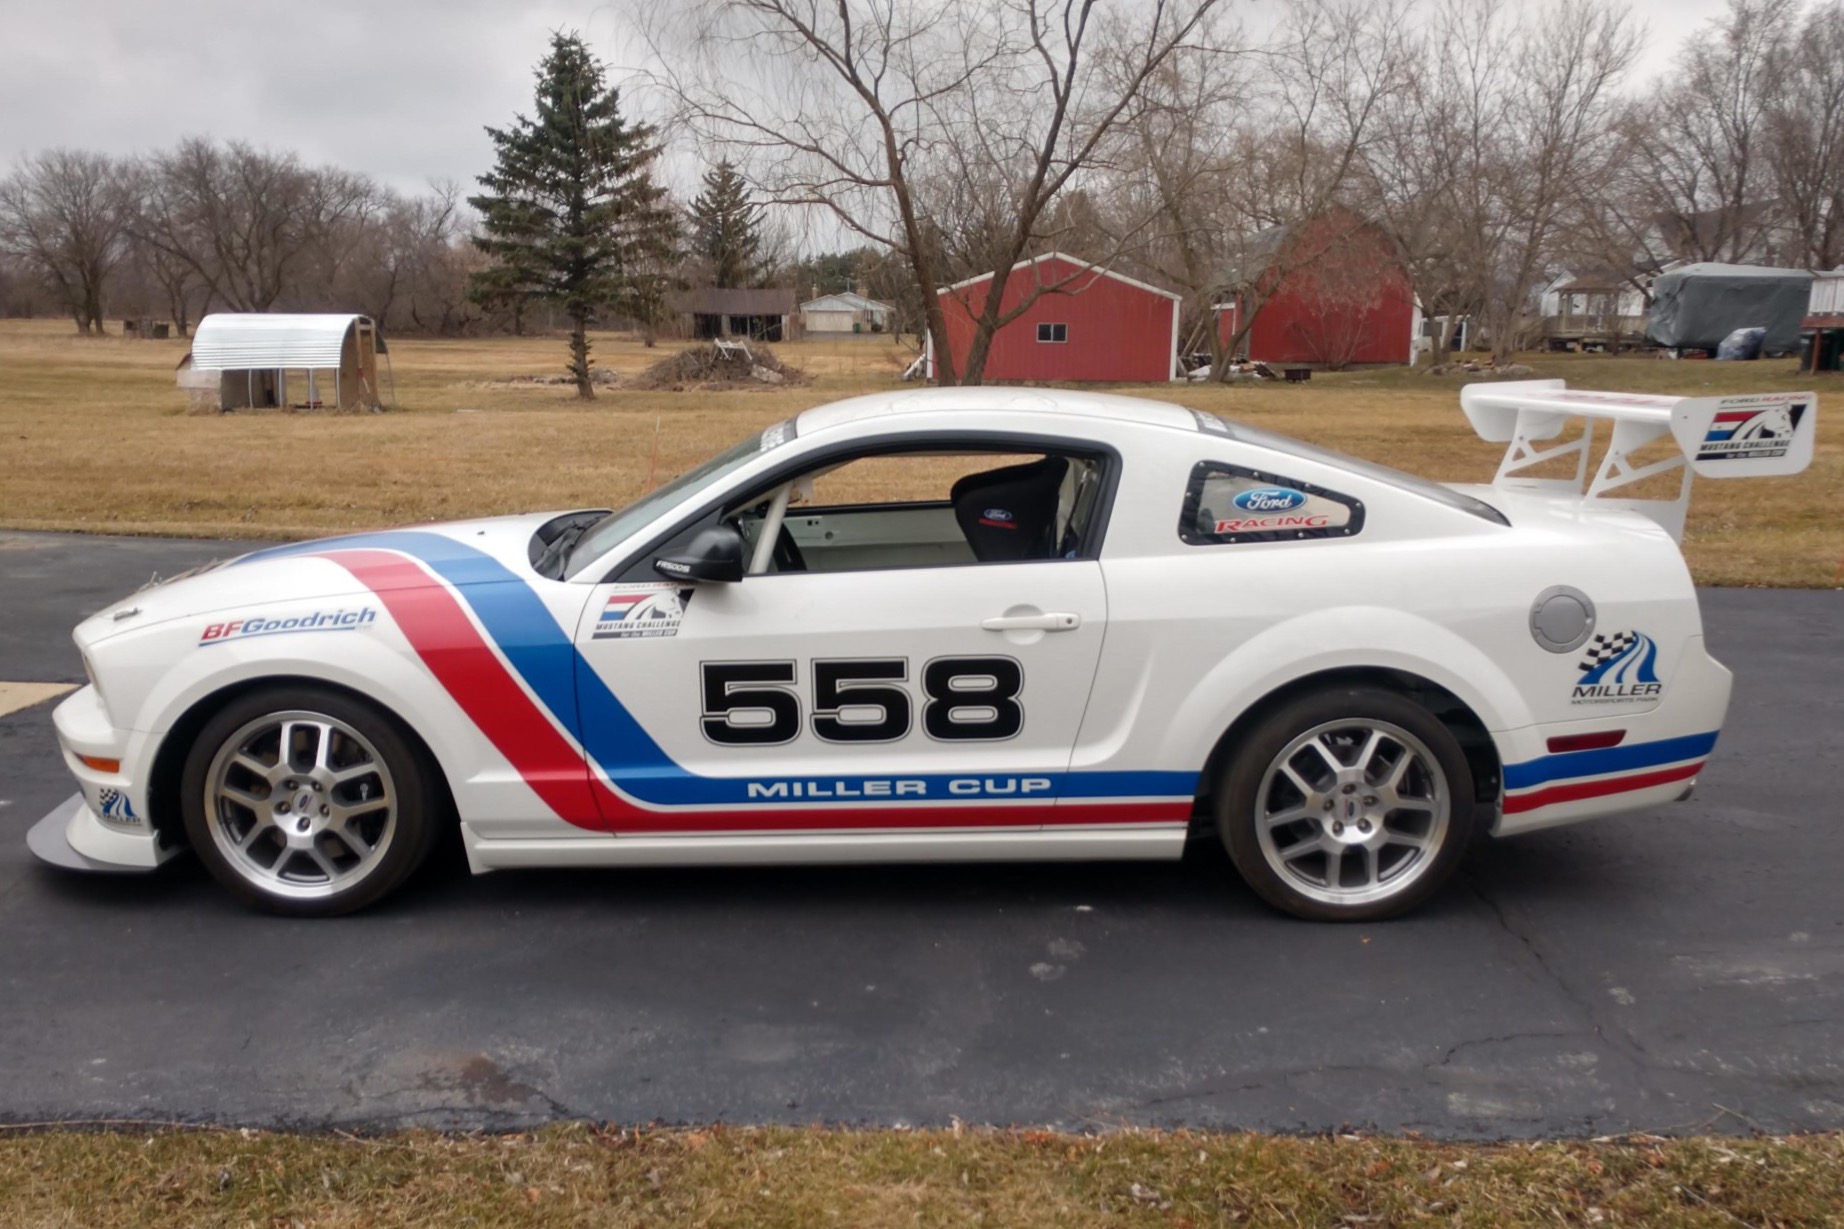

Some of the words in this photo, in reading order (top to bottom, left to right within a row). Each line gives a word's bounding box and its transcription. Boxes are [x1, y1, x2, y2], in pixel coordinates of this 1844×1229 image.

[1701, 442, 1741, 451] MUSTANG
[1743, 439, 1790, 449] CHALLENGE
[1247, 491, 1292, 509] Ford
[1216, 515, 1329, 533] RACING
[201, 607, 376, 640] BFGoodrich
[596, 622, 634, 630] MUSTANG
[637, 620, 681, 629] CHALLENGE
[1572, 684, 1662, 698] MILLER
[700, 654, 1025, 747] 558
[747, 780, 926, 798] MILLER
[948, 778, 1051, 794] CUP
